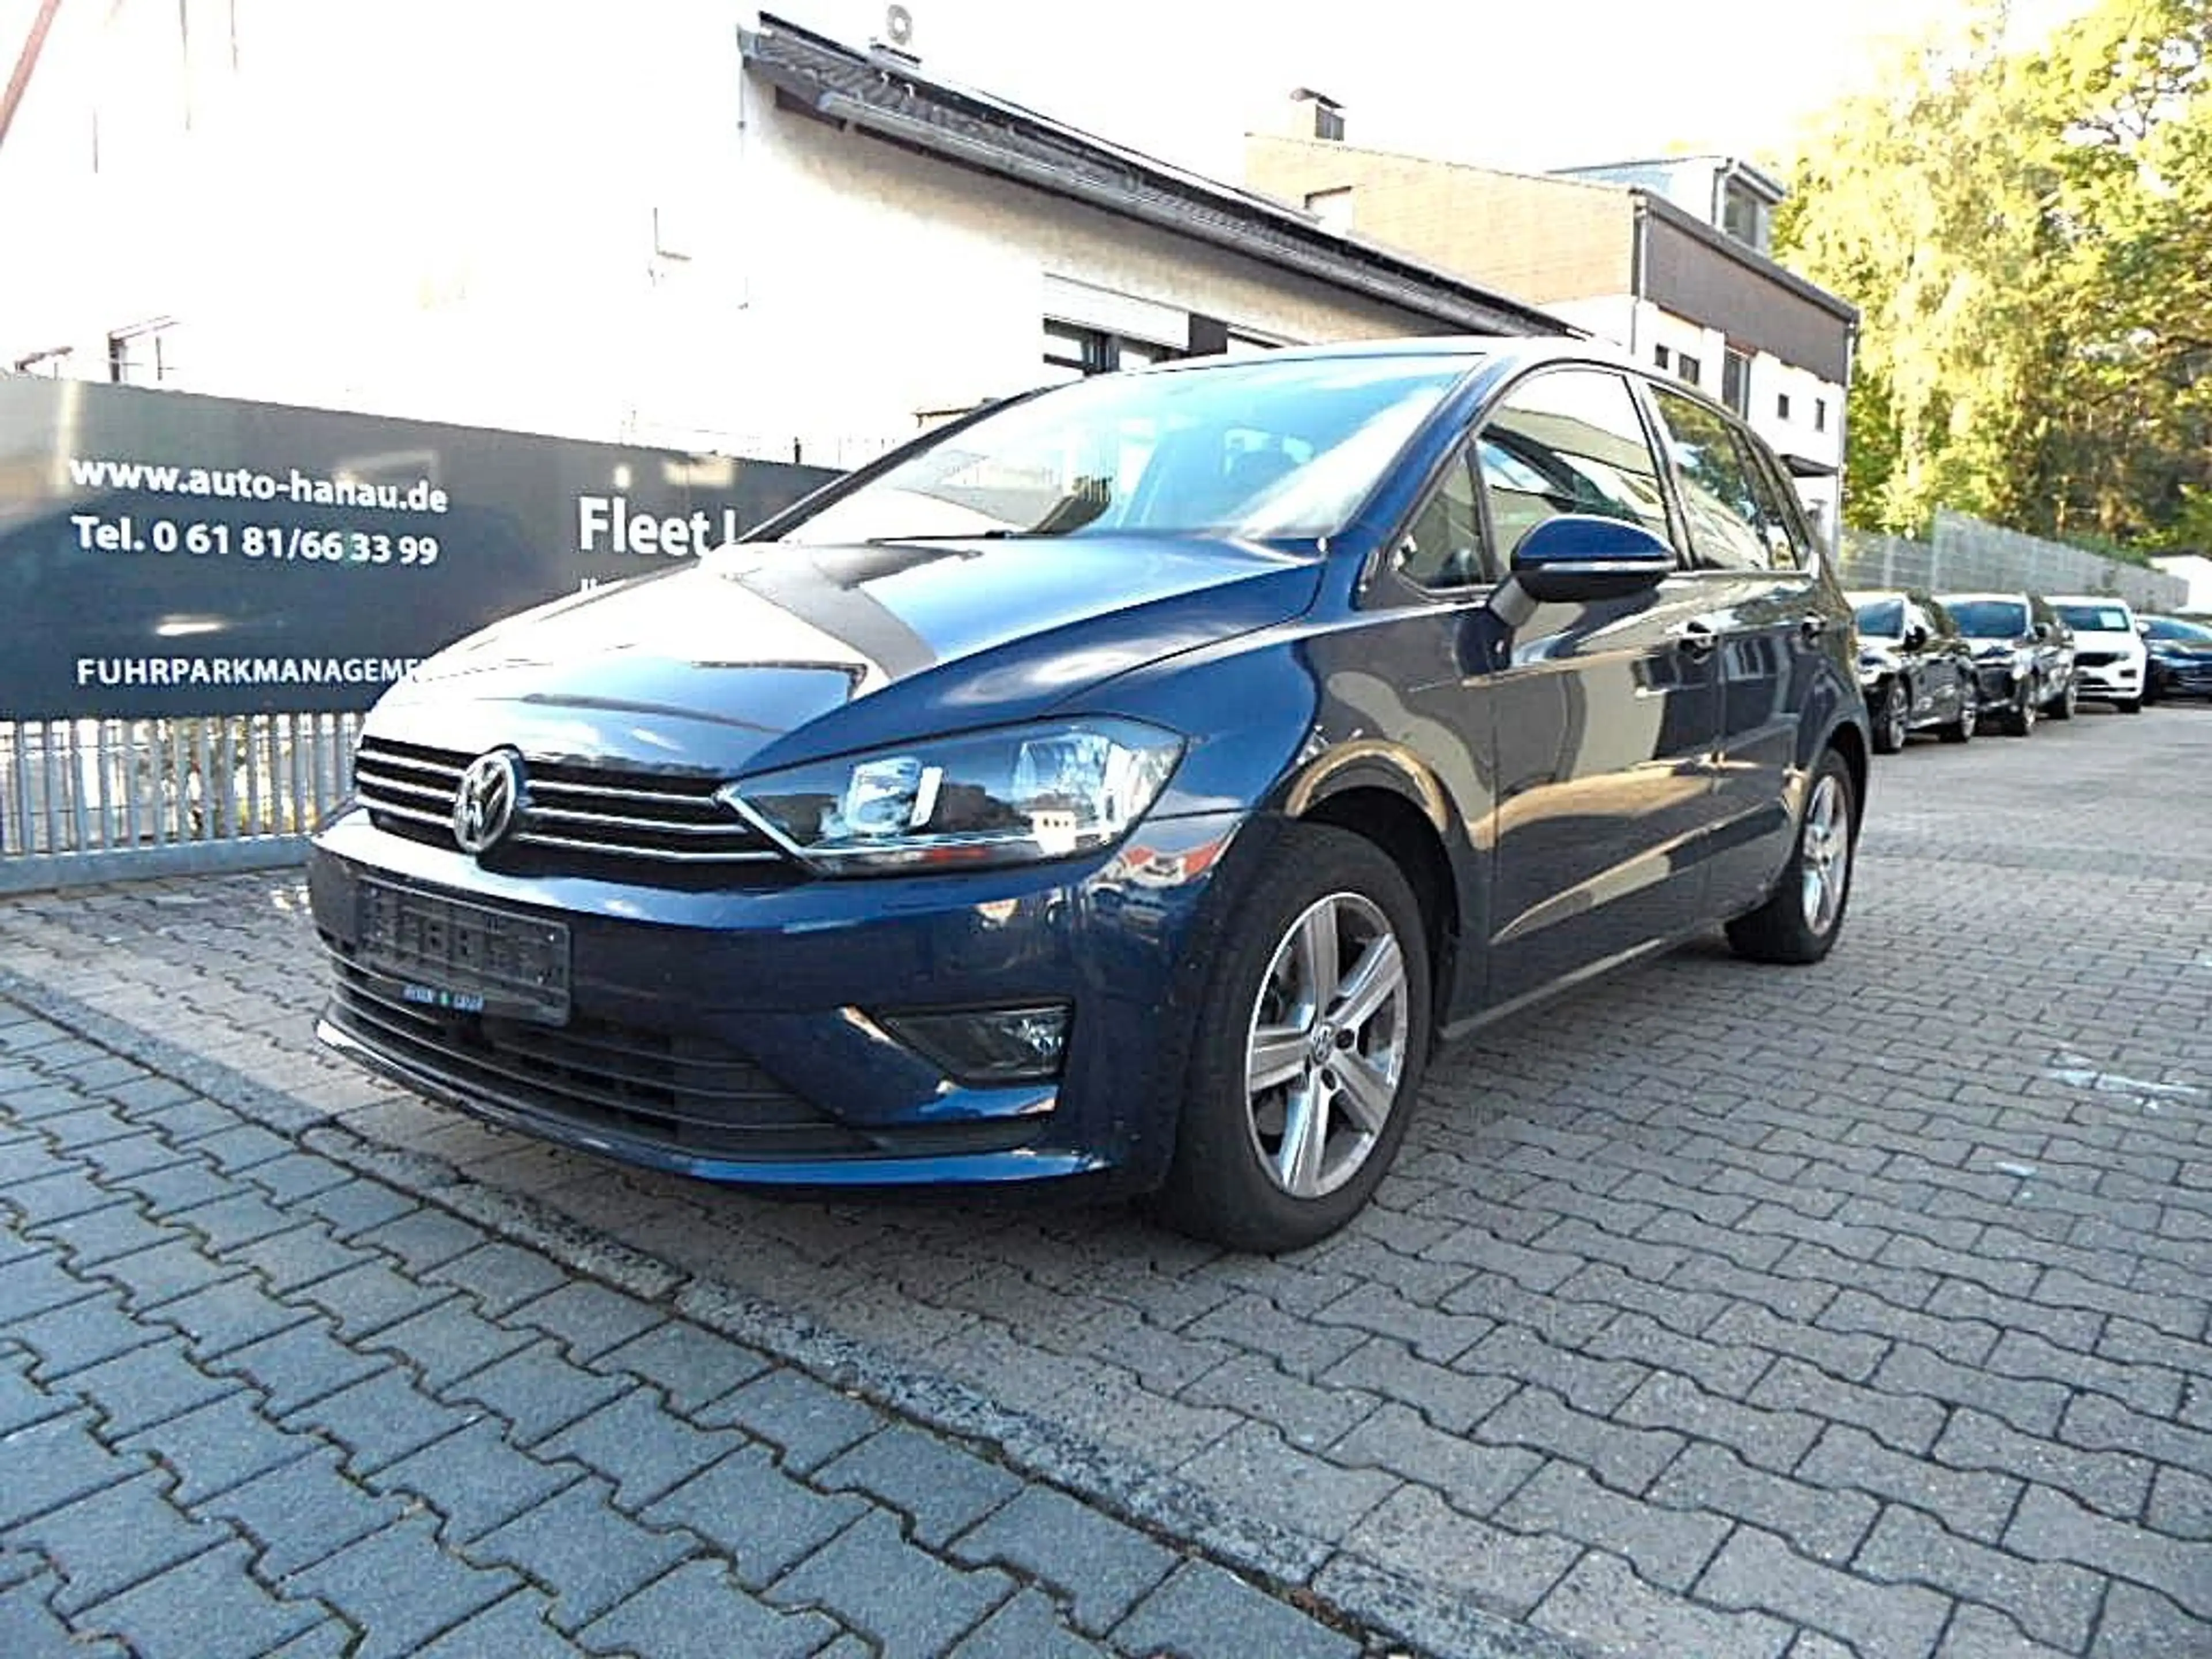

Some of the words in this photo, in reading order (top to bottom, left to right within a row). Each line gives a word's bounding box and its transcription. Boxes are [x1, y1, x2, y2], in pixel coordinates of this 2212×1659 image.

[69, 459, 448, 513] www.auto-hanau.de
[70, 516, 145, 551] Tel.
[153, 521, 177, 552] 0
[185, 524, 228, 554] 61
[242, 527, 343, 561] 81/66
[350, 532, 392, 563] 33
[399, 536, 438, 565] 99
[579, 496, 710, 556] Fleet
[77, 658, 427, 685] FUHRPARKMANAGEME
